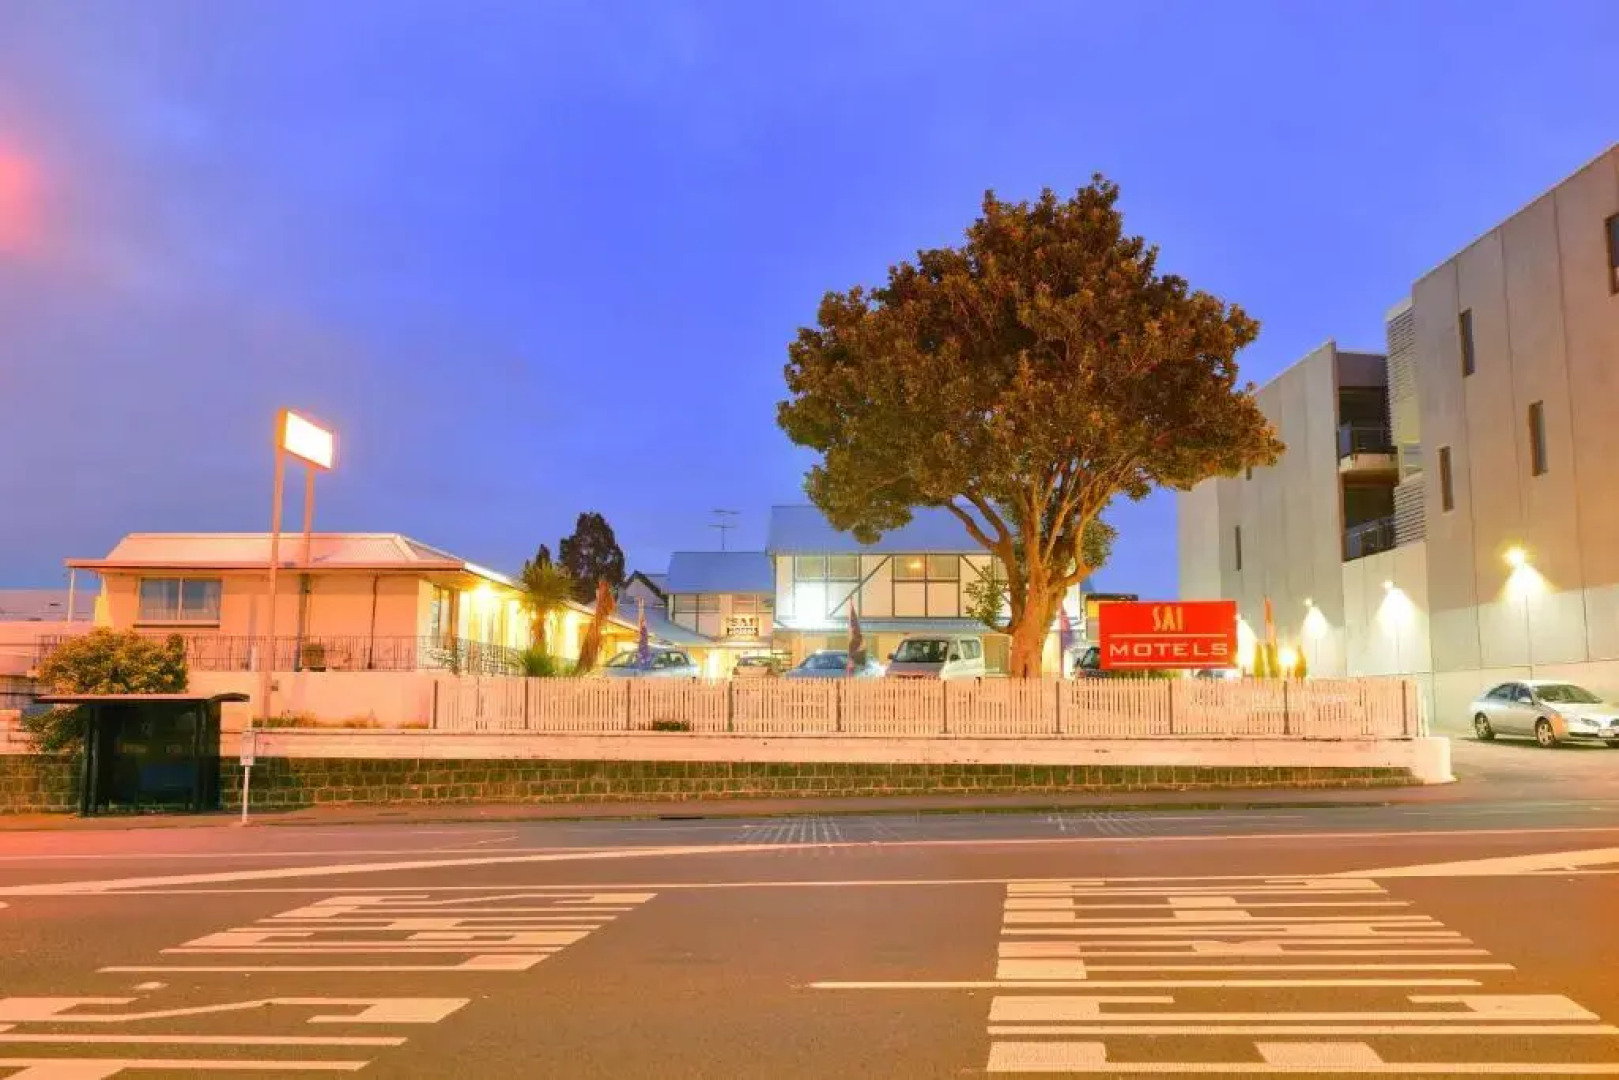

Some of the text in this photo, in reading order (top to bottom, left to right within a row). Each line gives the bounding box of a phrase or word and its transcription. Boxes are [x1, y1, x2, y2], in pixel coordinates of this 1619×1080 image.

[1152, 606, 1184, 632] SAI
[1109, 643, 1228, 657] MOTELS
[96, 892, 658, 972] LIGHTS
[995, 878, 1517, 980] TRAFFIC
